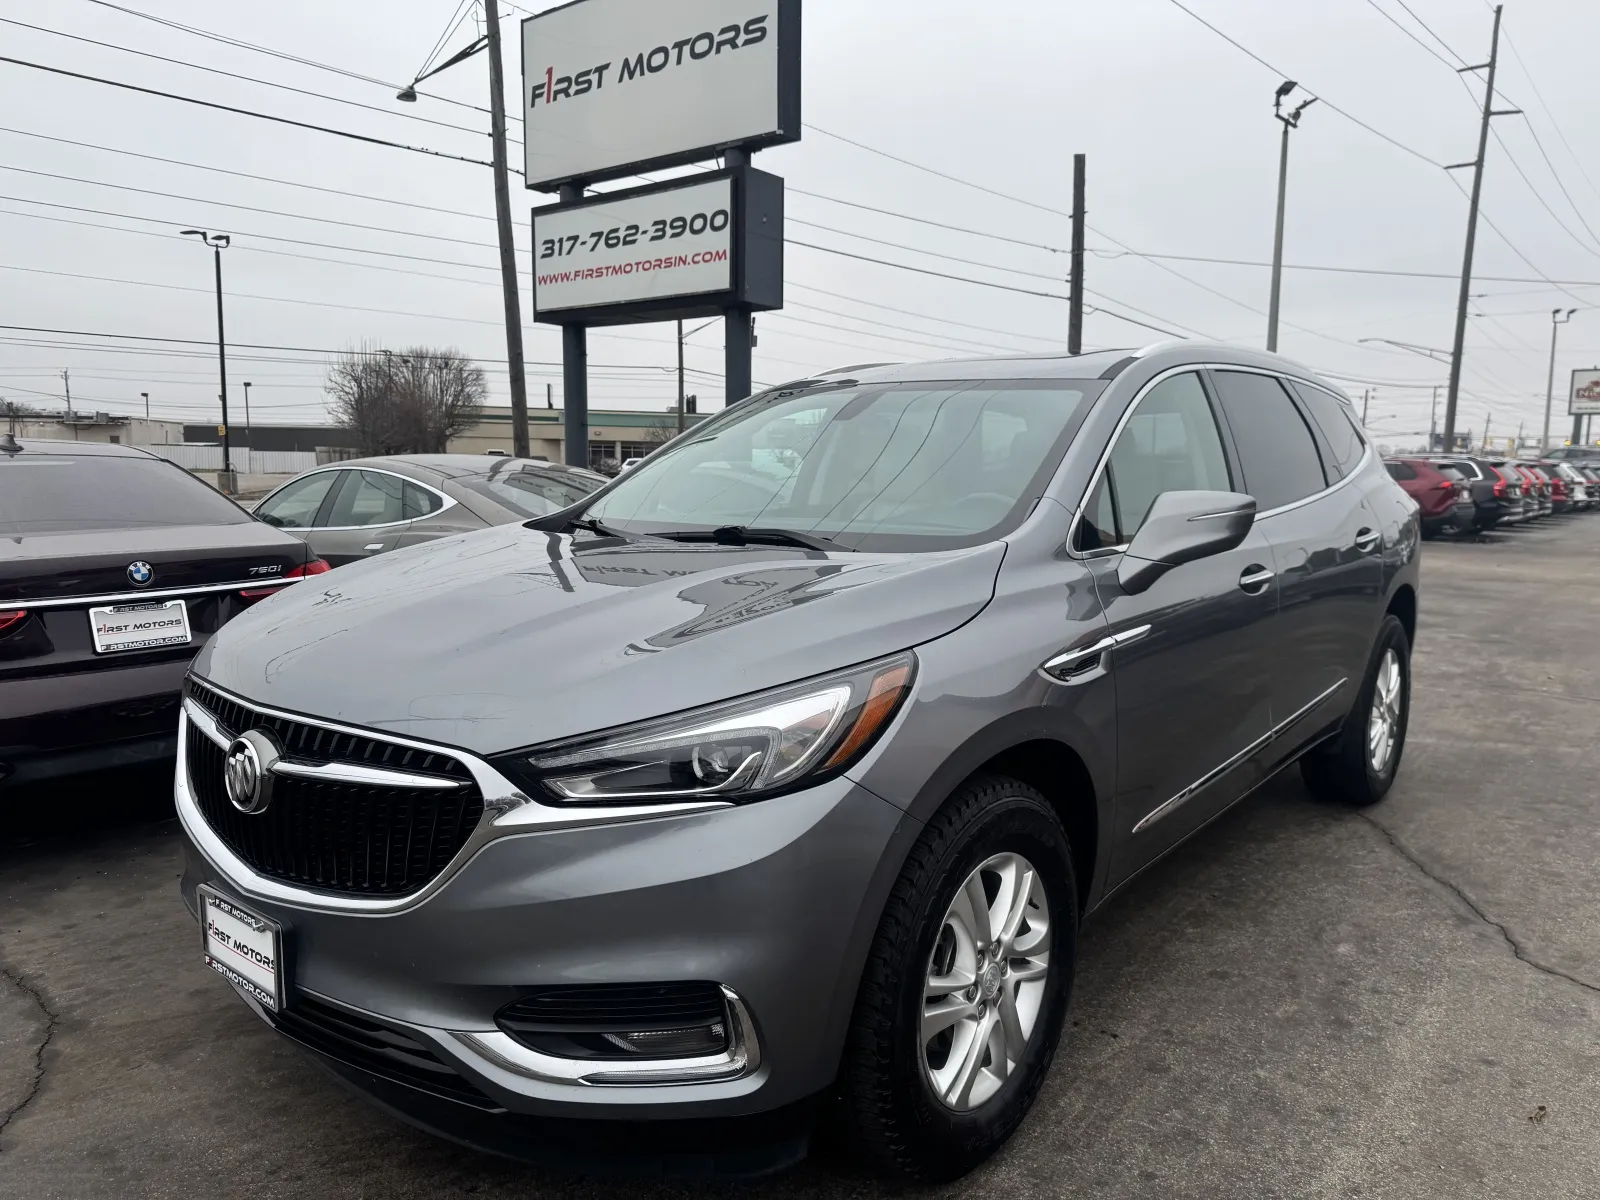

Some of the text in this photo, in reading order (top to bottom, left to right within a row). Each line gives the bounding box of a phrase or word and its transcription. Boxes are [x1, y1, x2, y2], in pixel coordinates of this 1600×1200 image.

[617, 14, 769, 84] MOTORS
[540, 209, 729, 259] 317-762-3900
[537, 249, 728, 286] WWW.FIRSTMOTORSIN.COM
[133, 618, 182, 630] MOTORS
[215, 899, 256, 926] FRST MOTORS
[233, 939, 275, 969] MOTORS
